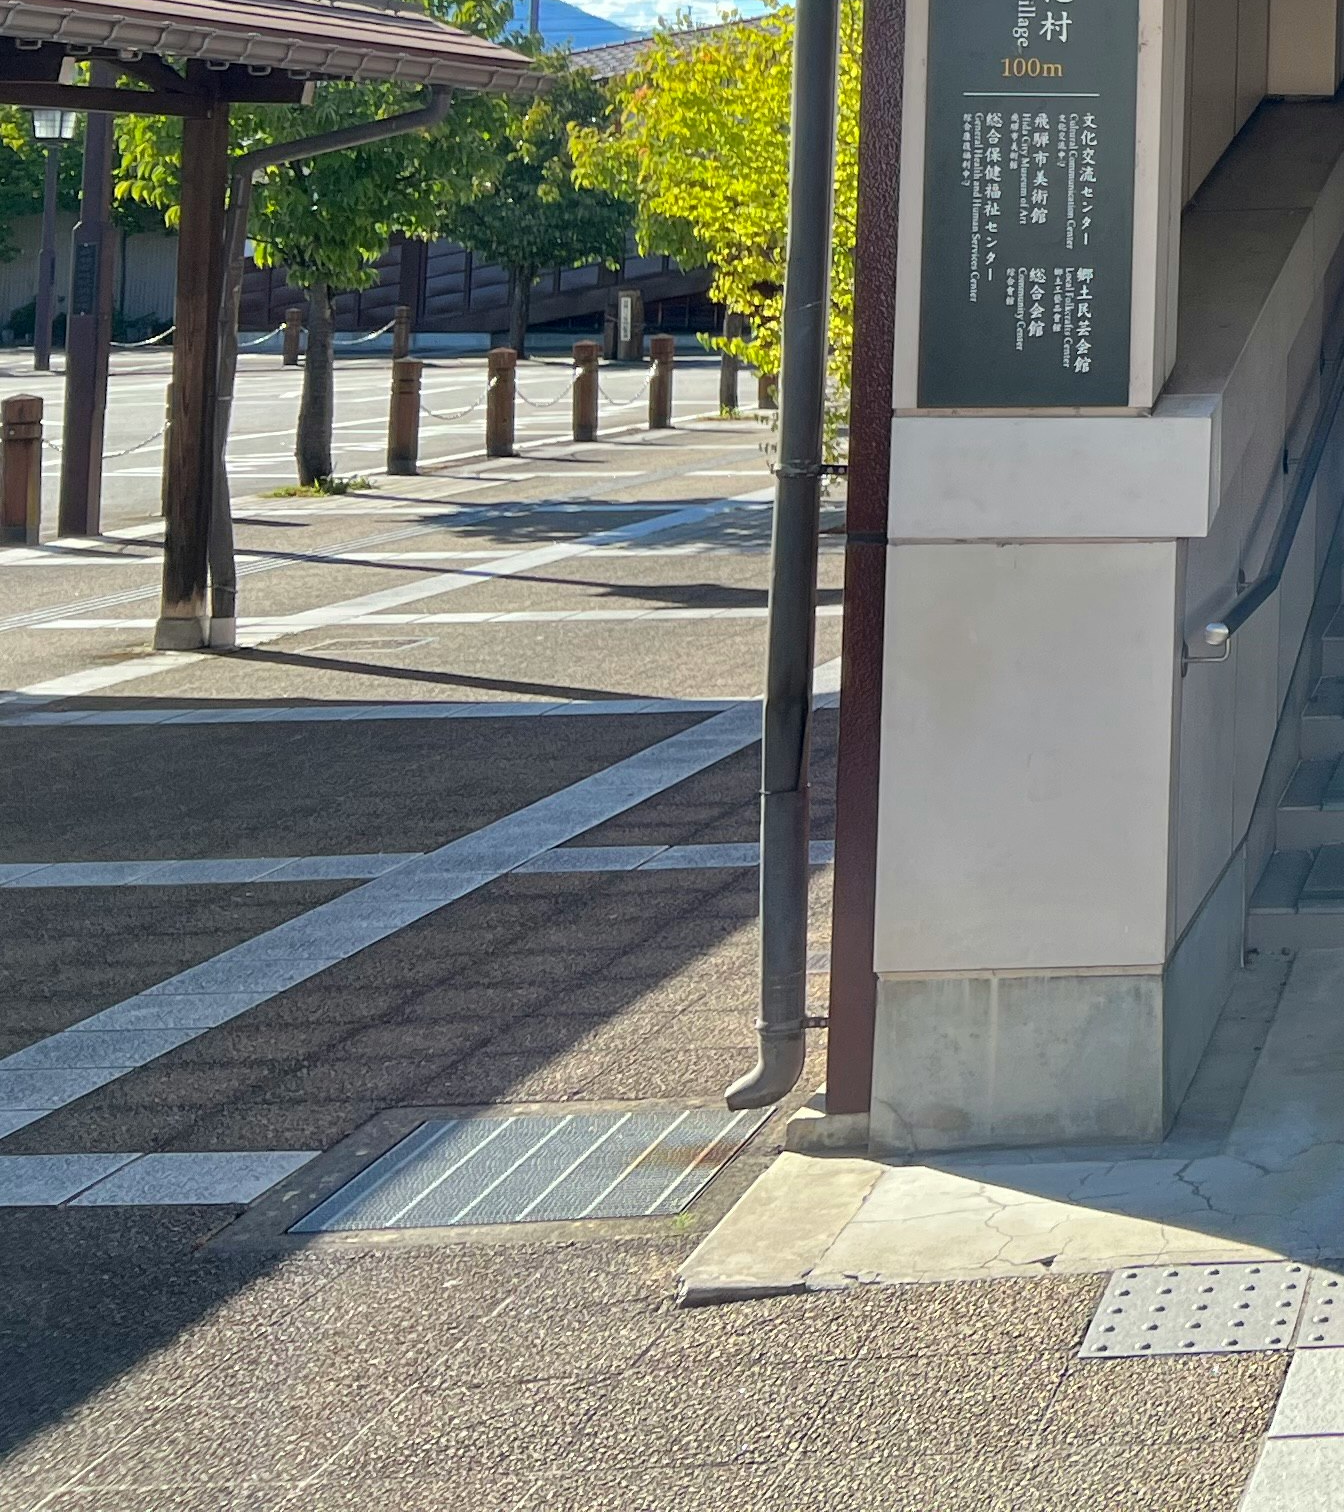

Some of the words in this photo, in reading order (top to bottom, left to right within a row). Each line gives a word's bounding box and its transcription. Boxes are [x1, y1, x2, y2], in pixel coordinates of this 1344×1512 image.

[1001, 57, 1063, 77] 100m
[974, 112, 984, 149] General
[1021, 113, 1032, 135] Hida
[1068, 113, 1079, 150] Cultural
[1019, 136, 1031, 158] City
[973, 149, 984, 180] Health
[1020, 158, 1030, 197] Museum
[1030, 112, 1050, 224] 飛騨市美術館
[1079, 112, 1098, 245] 文化交流センター
[972, 180, 983, 198] and
[983, 112, 1003, 281] 総合保健福祉センター
[1067, 150, 1078, 219] Communication
[971, 198, 982, 232] Human
[1019, 197, 1029, 208] of
[1019, 209, 1029, 225] Art
[970, 233, 981, 270] Services
[1065, 220, 1076, 250] Center
[969, 271, 980, 303] Center
[1014, 267, 1028, 321] Community
[1065, 267, 1075, 291] Local
[1027, 267, 1047, 337] 総合会館
[1064, 291, 1074, 336] Folkcrafts
[1015, 321, 1026, 351] Center
[1073, 267, 1094, 373] 郷土民芸会館
[1062, 337, 1073, 368] Center
